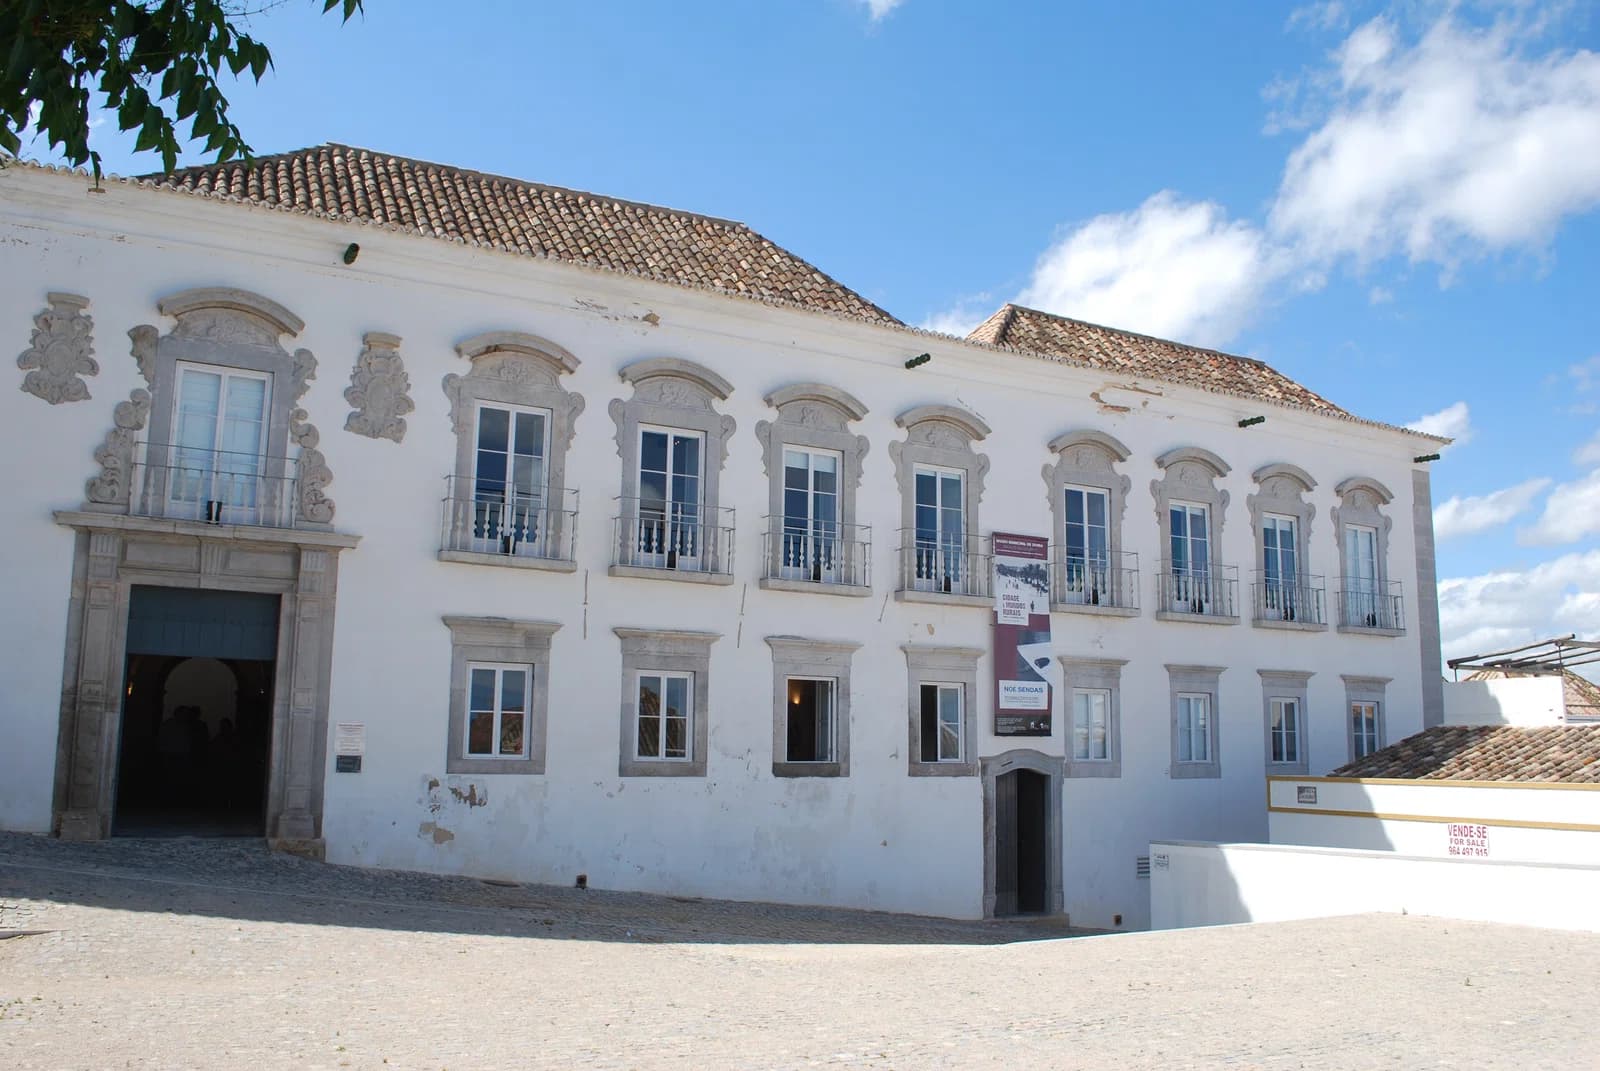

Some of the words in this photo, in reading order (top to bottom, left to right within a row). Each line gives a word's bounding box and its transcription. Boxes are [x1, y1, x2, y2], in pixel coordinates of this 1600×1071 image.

[1448, 824, 1487, 838] VENDE-SE
[1466, 839, 1485, 847] SALE
[1449, 846, 1460, 855] 964
[1462, 847, 1473, 856] 497
[1475, 848, 1488, 856] 915
